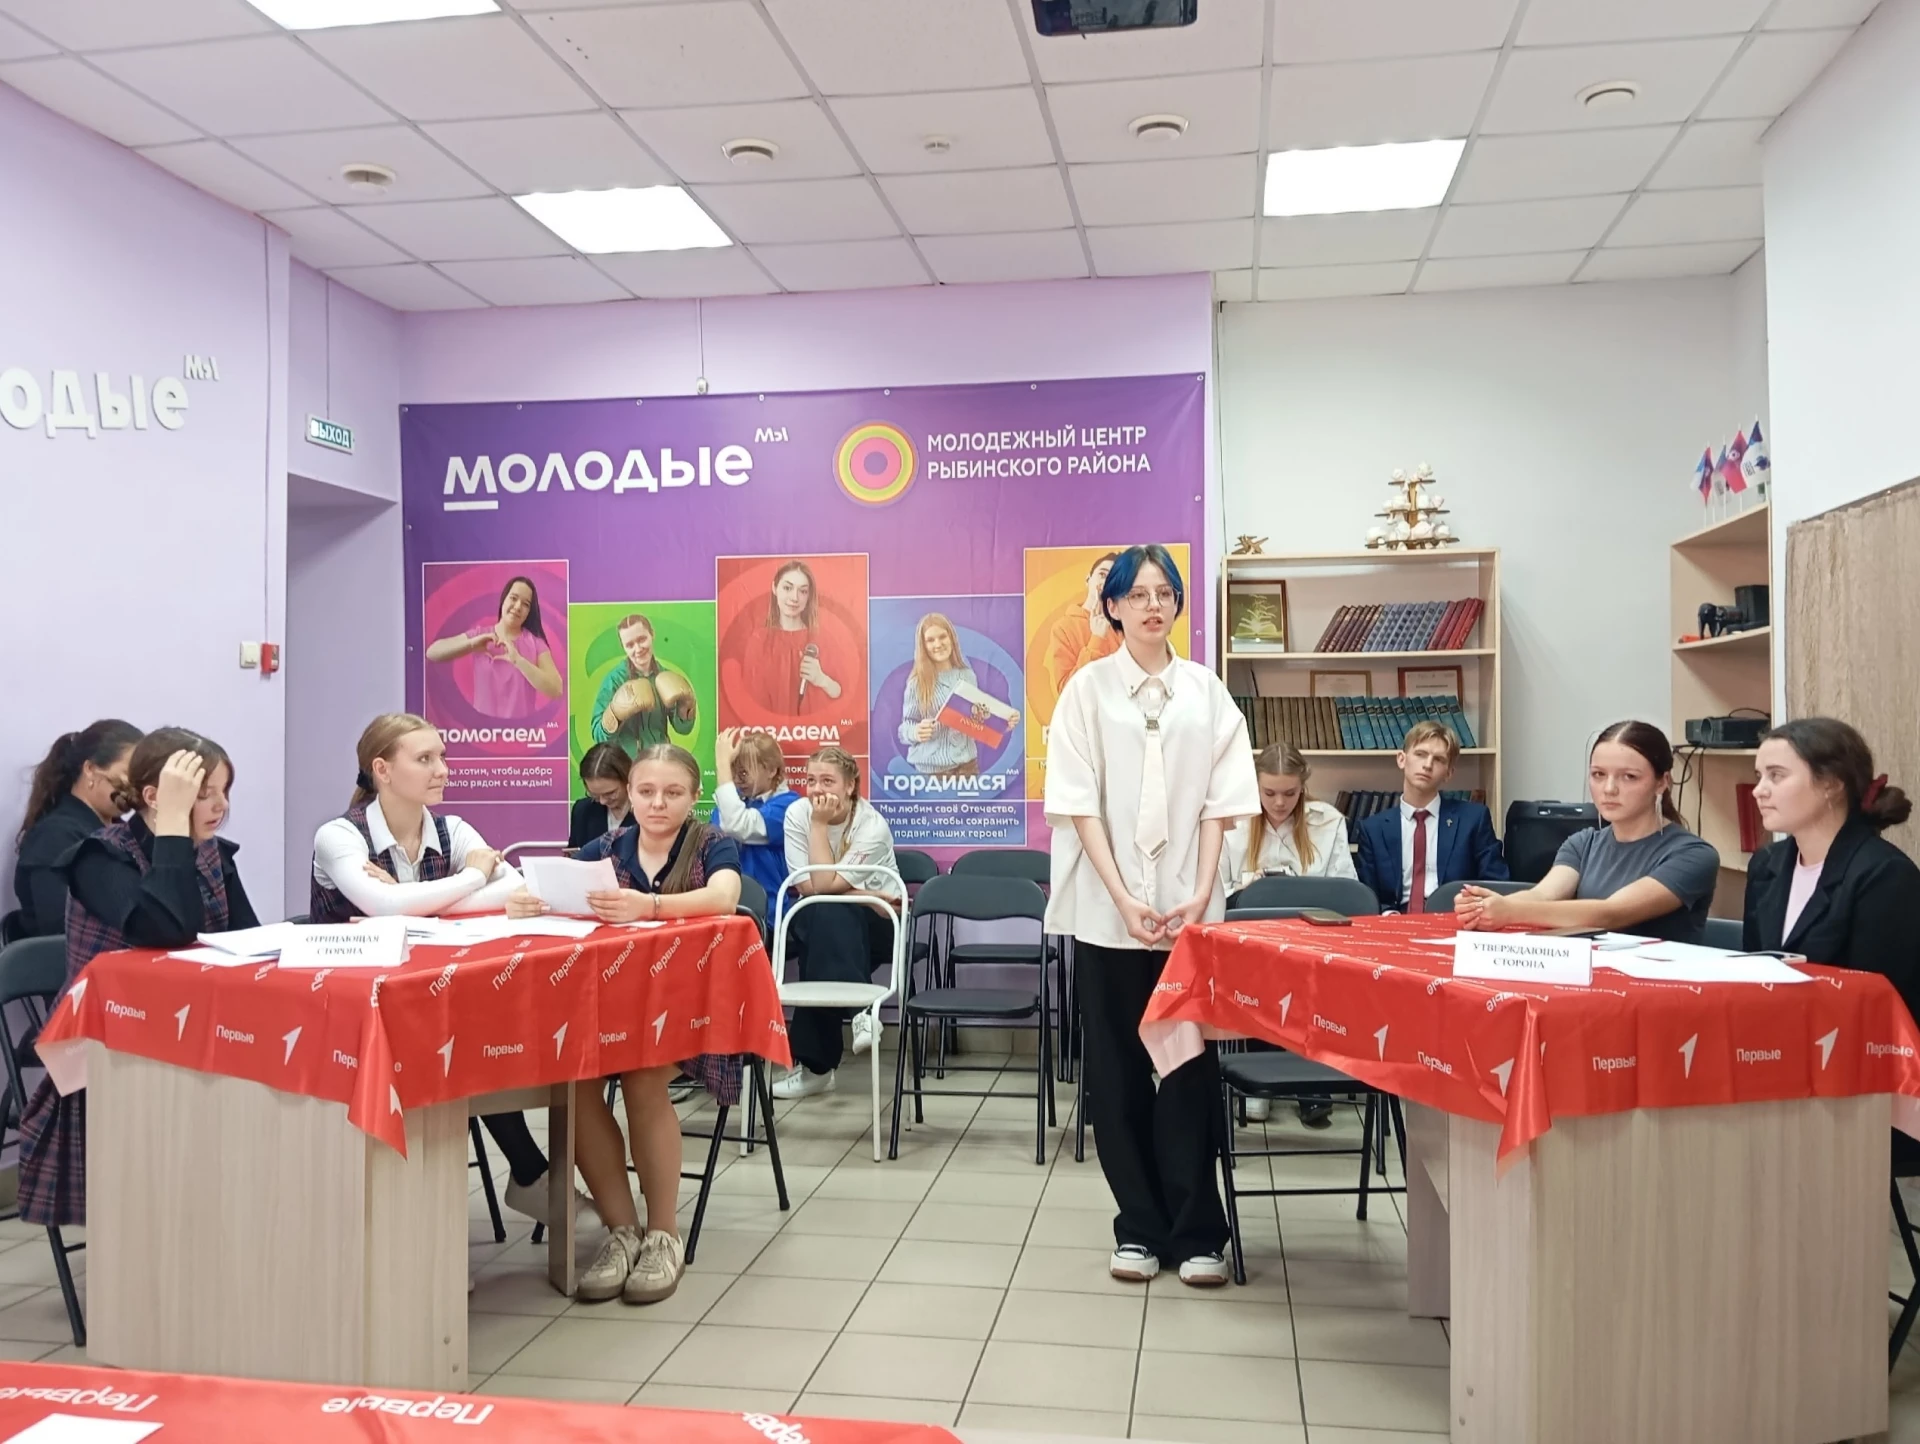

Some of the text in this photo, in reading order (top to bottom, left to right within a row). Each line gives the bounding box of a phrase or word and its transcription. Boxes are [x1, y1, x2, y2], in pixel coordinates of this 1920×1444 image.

[926, 425, 1147, 453] МОЛОДЕЖНЫЙ ЦЕНТР
[443, 445, 754, 494] молодые
[926, 451, 1152, 480] РЫБИНСКОГО РАЙОНА
[459, 768, 489, 777] хотим,
[491, 766, 521, 776] чтобы
[522, 766, 553, 777] добро
[470, 780, 501, 789] рядом
[510, 777, 553, 788] каждым!
[883, 774, 1006, 797] гордимся
[879, 803, 1017, 814] Мы любим своё Отечество,
[910, 816, 930, 827] всё,
[932, 815, 964, 826] чтобы
[965, 817, 1020, 828] сохранить
[894, 829, 1007, 840] подвиг наших героев!
[316, 947, 363, 955] СТОРОНА
[650, 936, 681, 978] Первые
[1473, 943, 1570, 958] УТВЕРЖДАЮЩАЯ
[549, 943, 584, 987] Первые
[602, 940, 635, 983] Первые
[1493, 957, 1545, 969] СТОРОНА
[1233, 989, 1260, 1008] Первые
[105, 1000, 146, 1020] Первые
[216, 1025, 255, 1043] Первые
[1313, 1013, 1347, 1037] Первые
[483, 1043, 524, 1059] Первые
[1736, 1047, 1782, 1065] Первые
[1866, 1041, 1914, 1058] Первые
[1418, 1051, 1453, 1075] Первые
[1592, 1055, 1637, 1074] Первые
[321, 1395, 496, 1425] Первые
